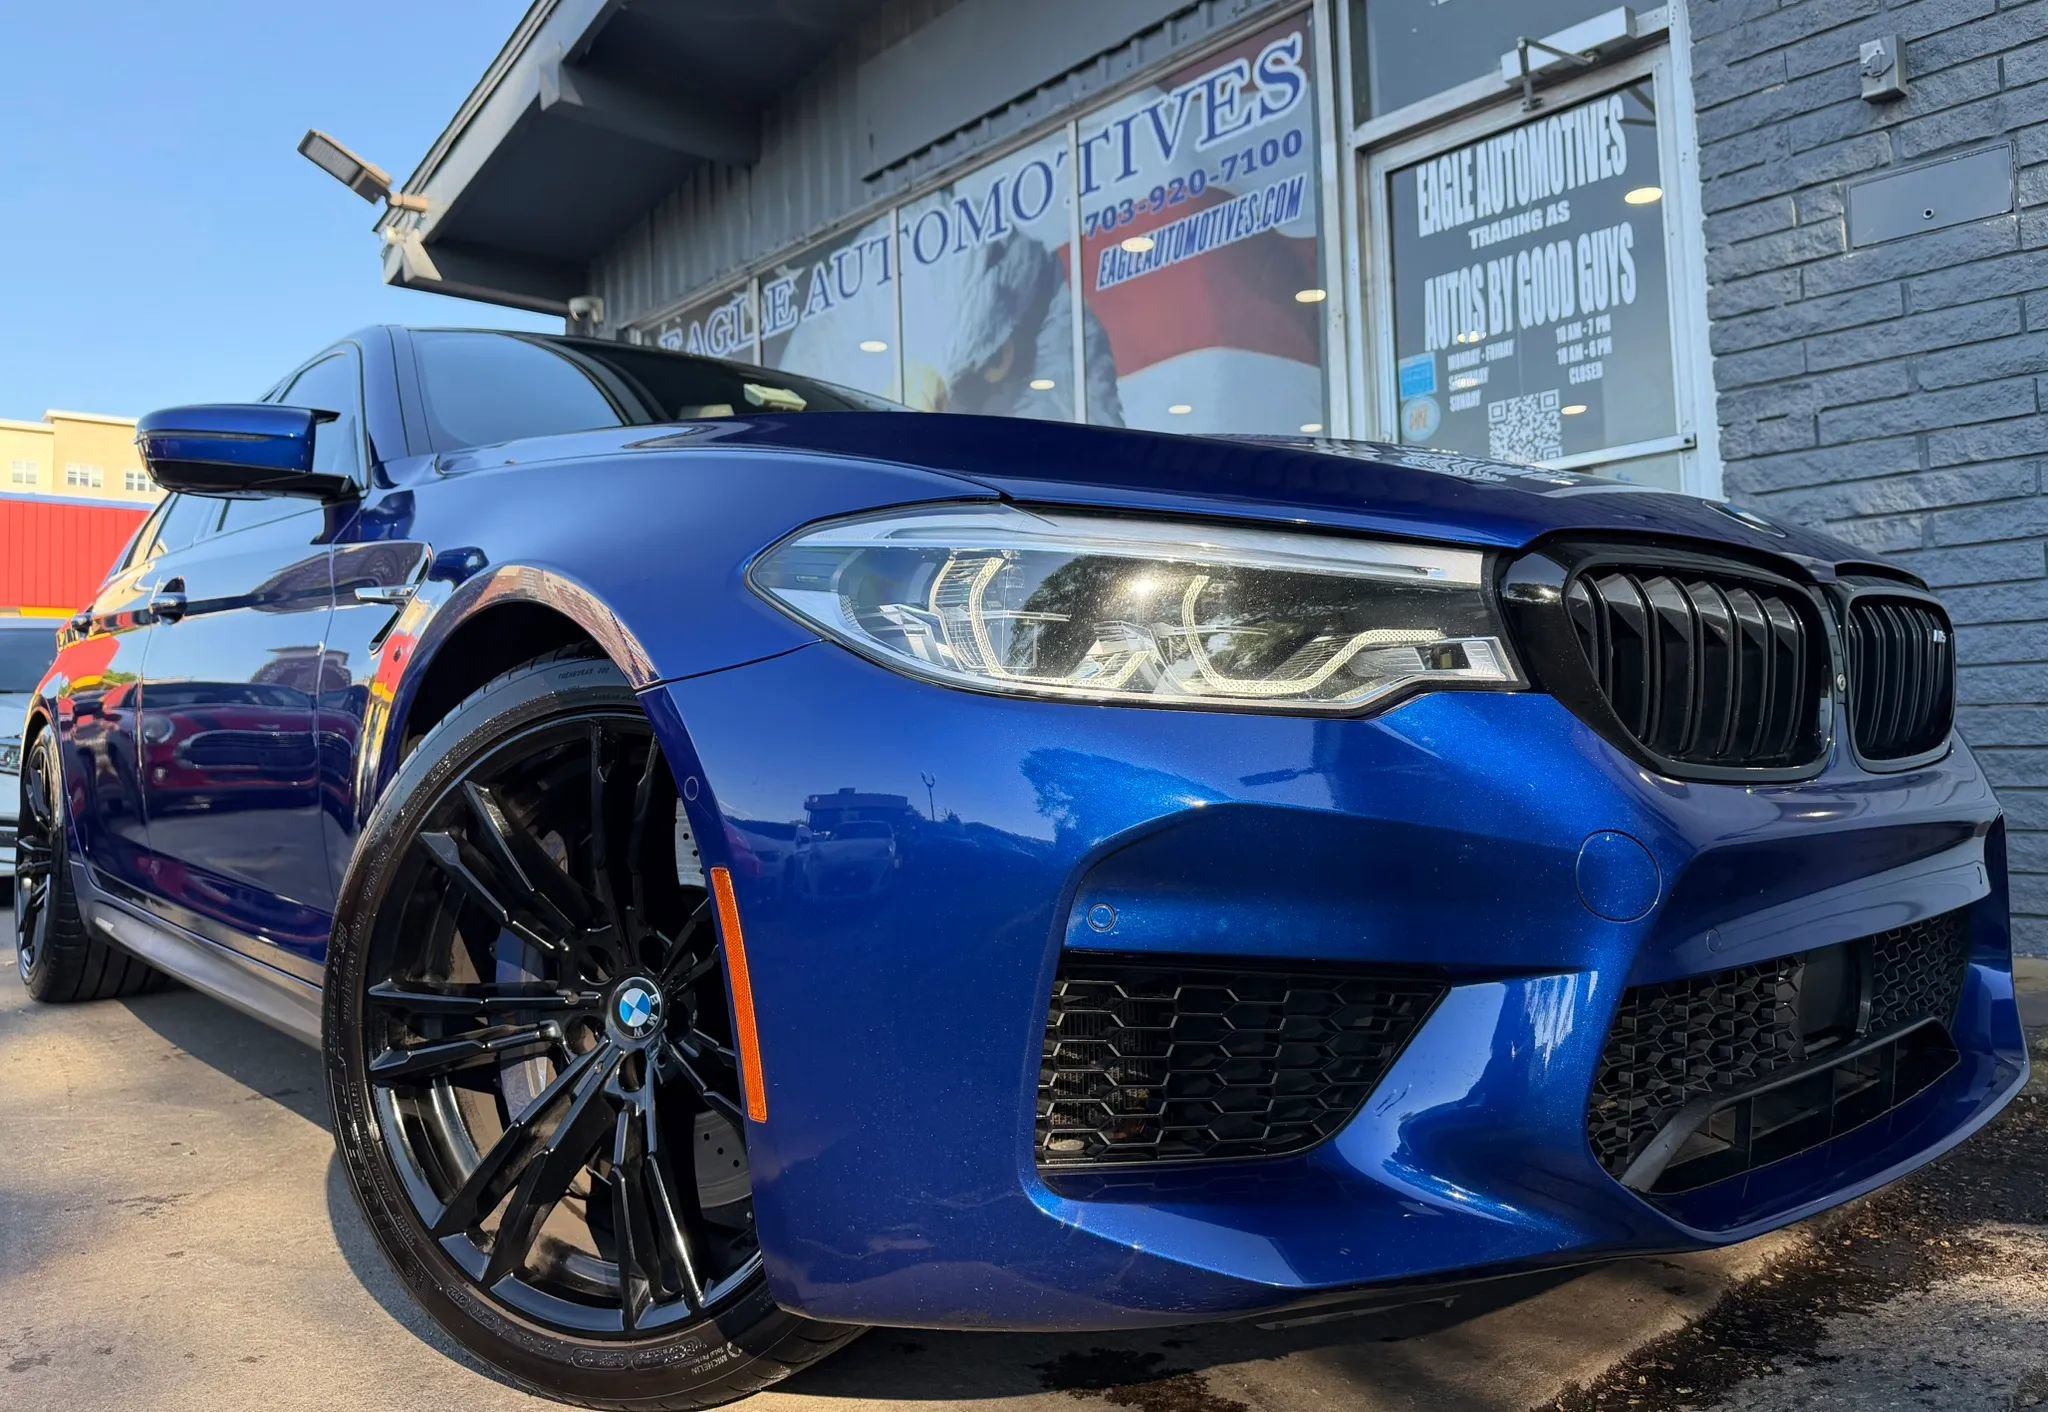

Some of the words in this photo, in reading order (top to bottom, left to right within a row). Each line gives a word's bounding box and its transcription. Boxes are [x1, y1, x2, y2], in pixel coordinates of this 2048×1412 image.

[802, 37, 1306, 318] AUTOMOTIVES
[1084, 128, 1304, 238] 703-920-7100
[1415, 146, 1475, 238] EAGLE
[1475, 93, 1628, 219] AUTOMOTIVES
[1097, 174, 1305, 289] EAGLEAUTOMOTIVES.COM
[1467, 207, 1544, 250] TRADING
[1545, 199, 1571, 228] AS
[1424, 262, 1487, 352] AUTOS
[1486, 254, 1514, 337] BY
[1516, 238, 1576, 330] GOOD
[1577, 220, 1637, 315] GUYS
[1485, 338, 1515, 362] FRIDAY
[1555, 324, 1567, 345] 10
[1567, 320, 1583, 342] AM
[1587, 317, 1594, 336] 7
[1595, 313, 1611, 335] PM
[1556, 346, 1568, 366] 10
[1568, 342, 1584, 363] AM
[1597, 335, 1613, 356] PM
[1568, 360, 1603, 385] CLOSED
[690, 1353, 729, 1377] MICHELIN
